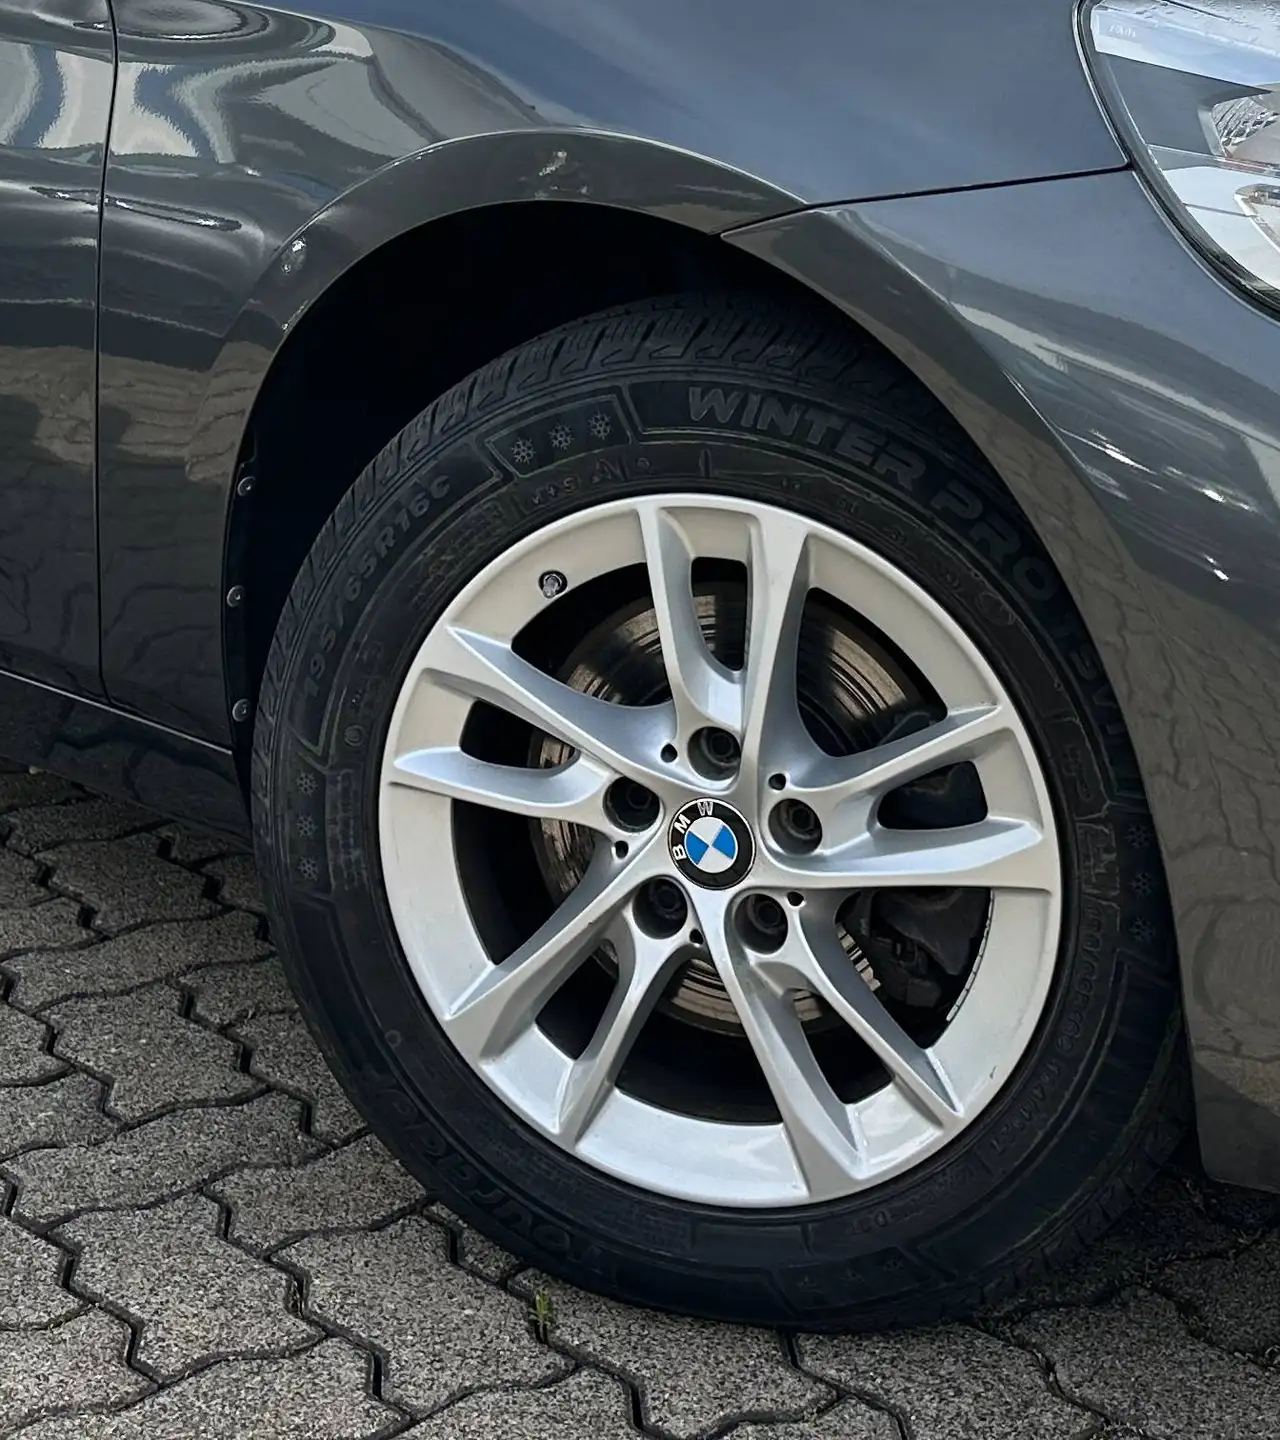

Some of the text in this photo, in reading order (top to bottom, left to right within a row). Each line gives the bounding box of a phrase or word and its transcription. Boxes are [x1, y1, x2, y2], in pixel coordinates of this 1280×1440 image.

[301, 473, 453, 700] 195/65R16C
[688, 386, 927, 492] WINTER
[930, 481, 1060, 603] PRO
[671, 800, 714, 861] BMW
